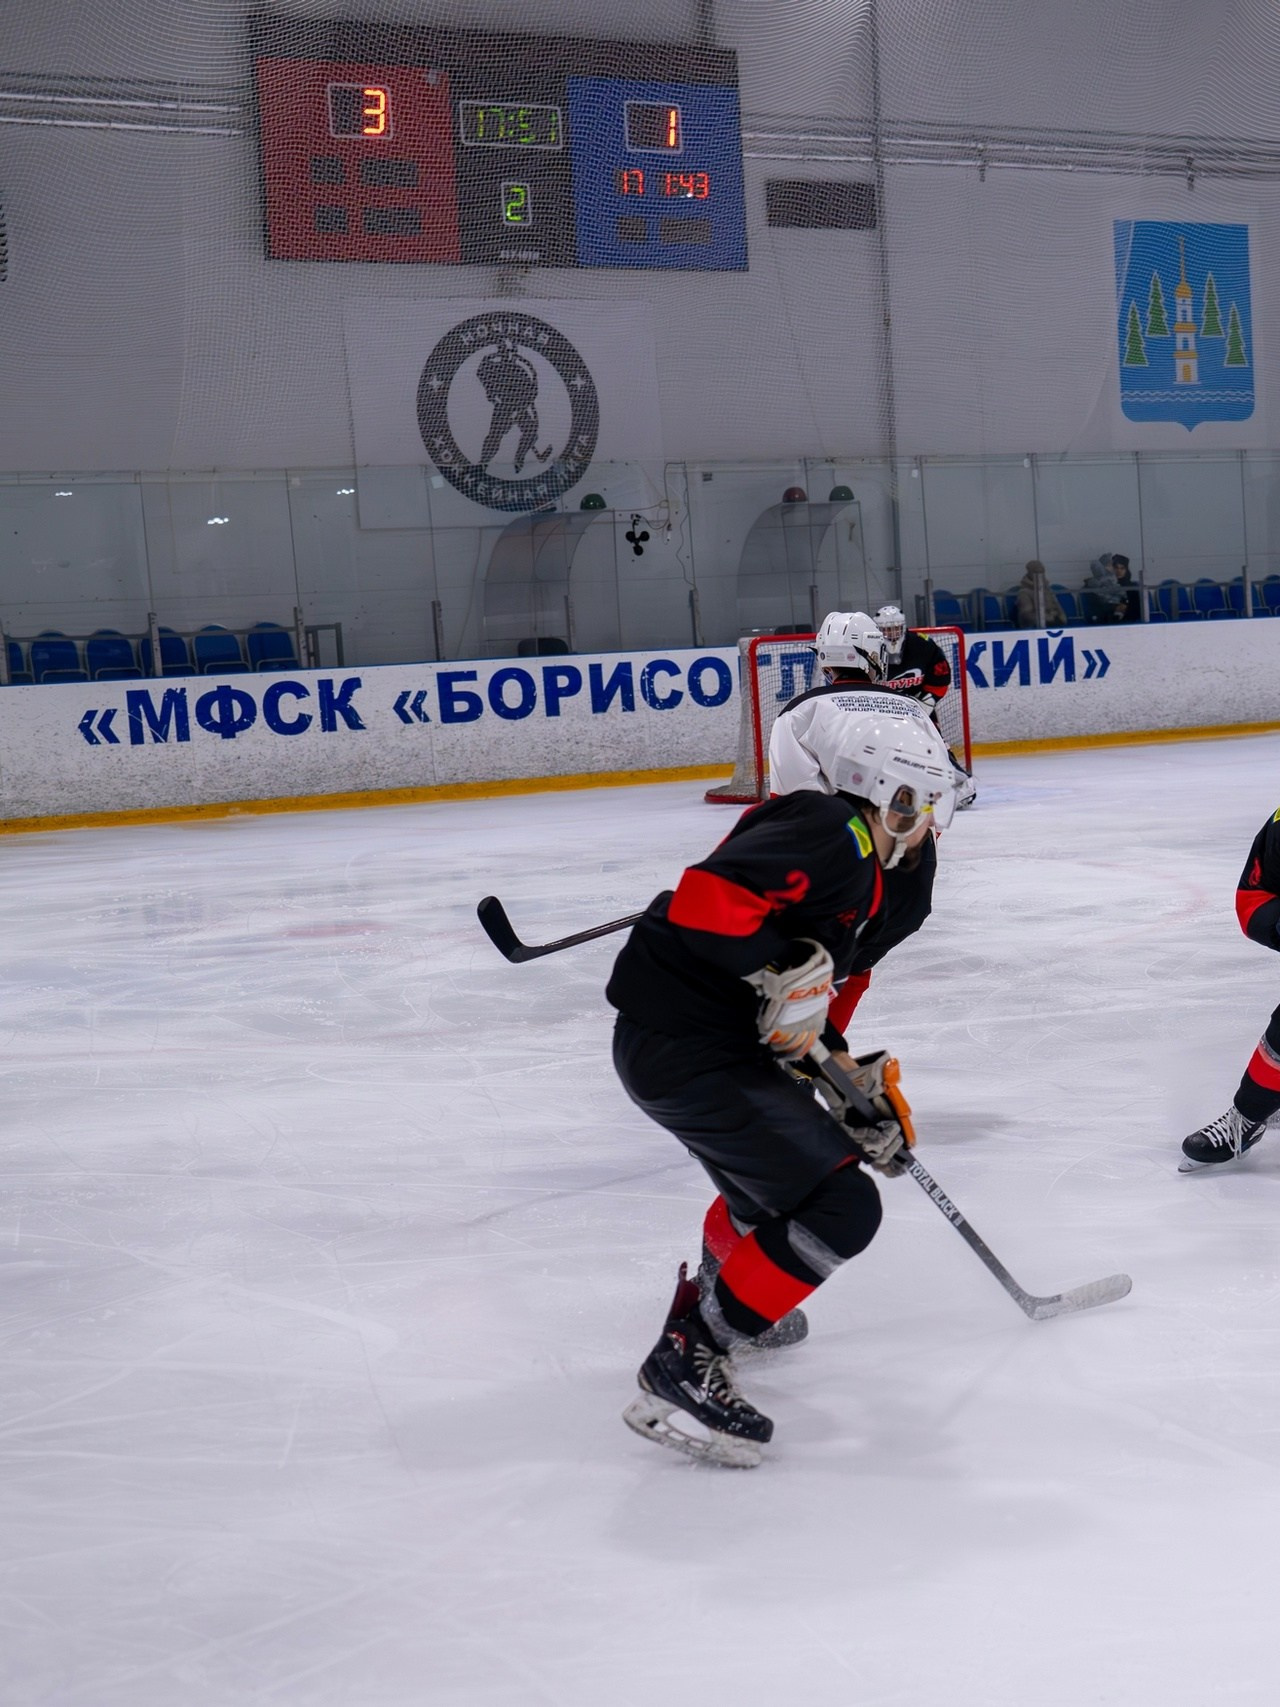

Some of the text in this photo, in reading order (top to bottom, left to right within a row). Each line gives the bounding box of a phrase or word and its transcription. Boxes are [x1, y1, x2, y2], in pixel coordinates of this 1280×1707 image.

[362, 88, 386, 136] 3
[667, 108, 677, 147] 1
[505, 186, 526, 221] 2
[459, 321, 551, 346] НОЧНАЯ
[76, 676, 367, 747] «МФСК
[909, 1160, 958, 1219] TOTAL BLACK
